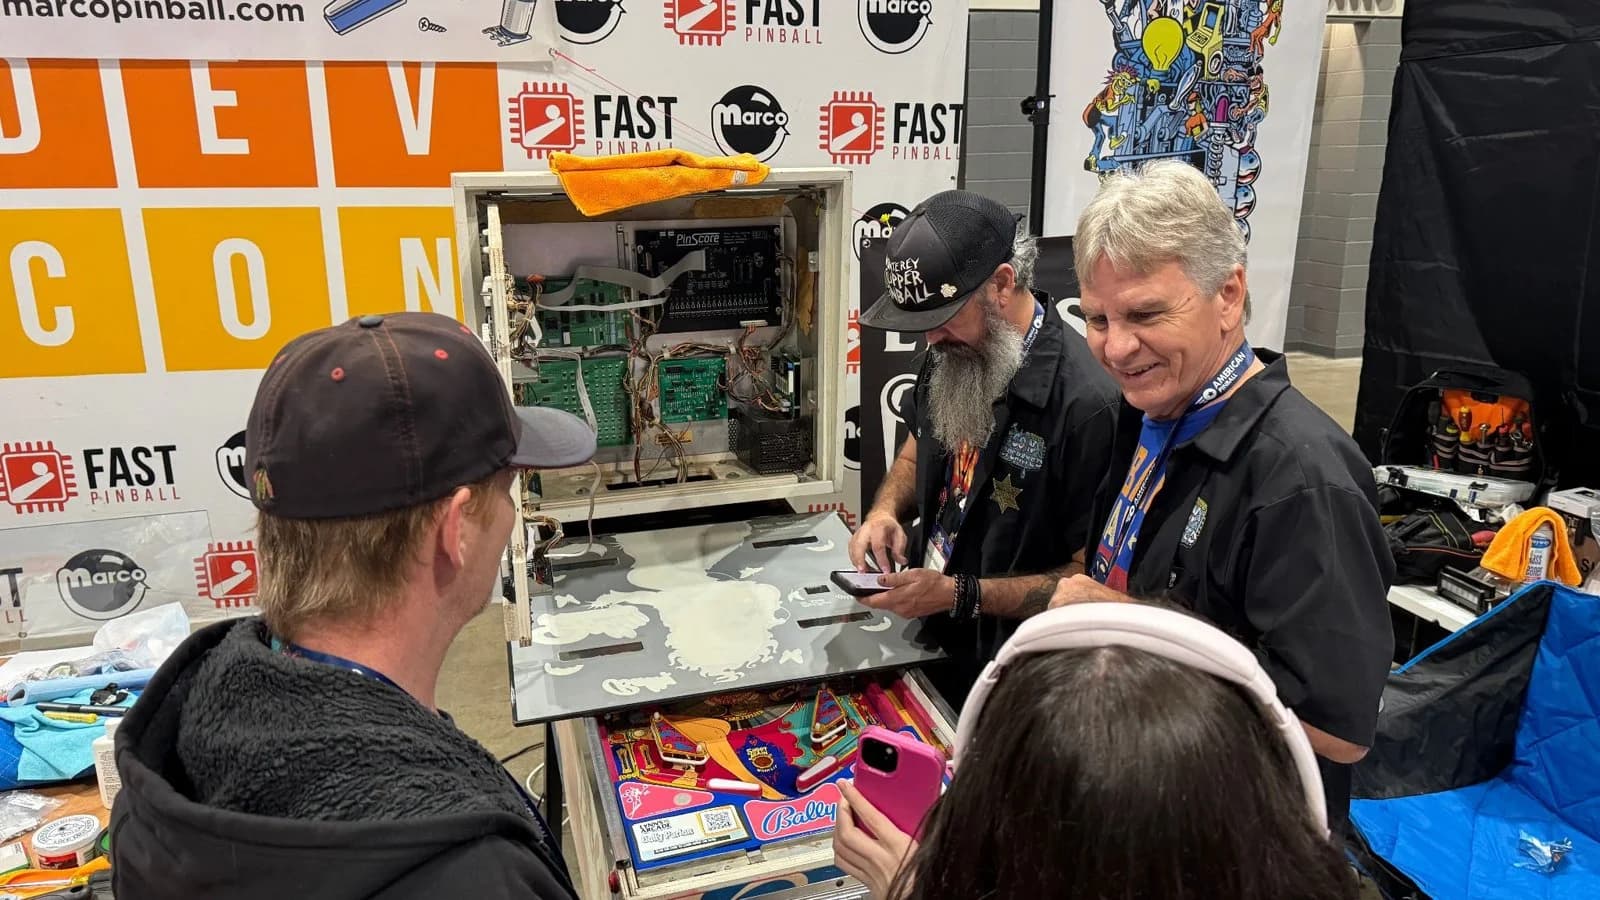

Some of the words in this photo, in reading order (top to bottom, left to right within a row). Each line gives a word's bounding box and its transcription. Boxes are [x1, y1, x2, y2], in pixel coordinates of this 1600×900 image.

[3, 0, 305, 23] marcopinball.com
[745, 27, 822, 45] PINBALL
[594, 95, 678, 140] FAST
[893, 103, 963, 144] FAST
[84, 445, 176, 489] FAST
[90, 487, 181, 504] PINBALL
[763, 800, 836, 834] Bally
